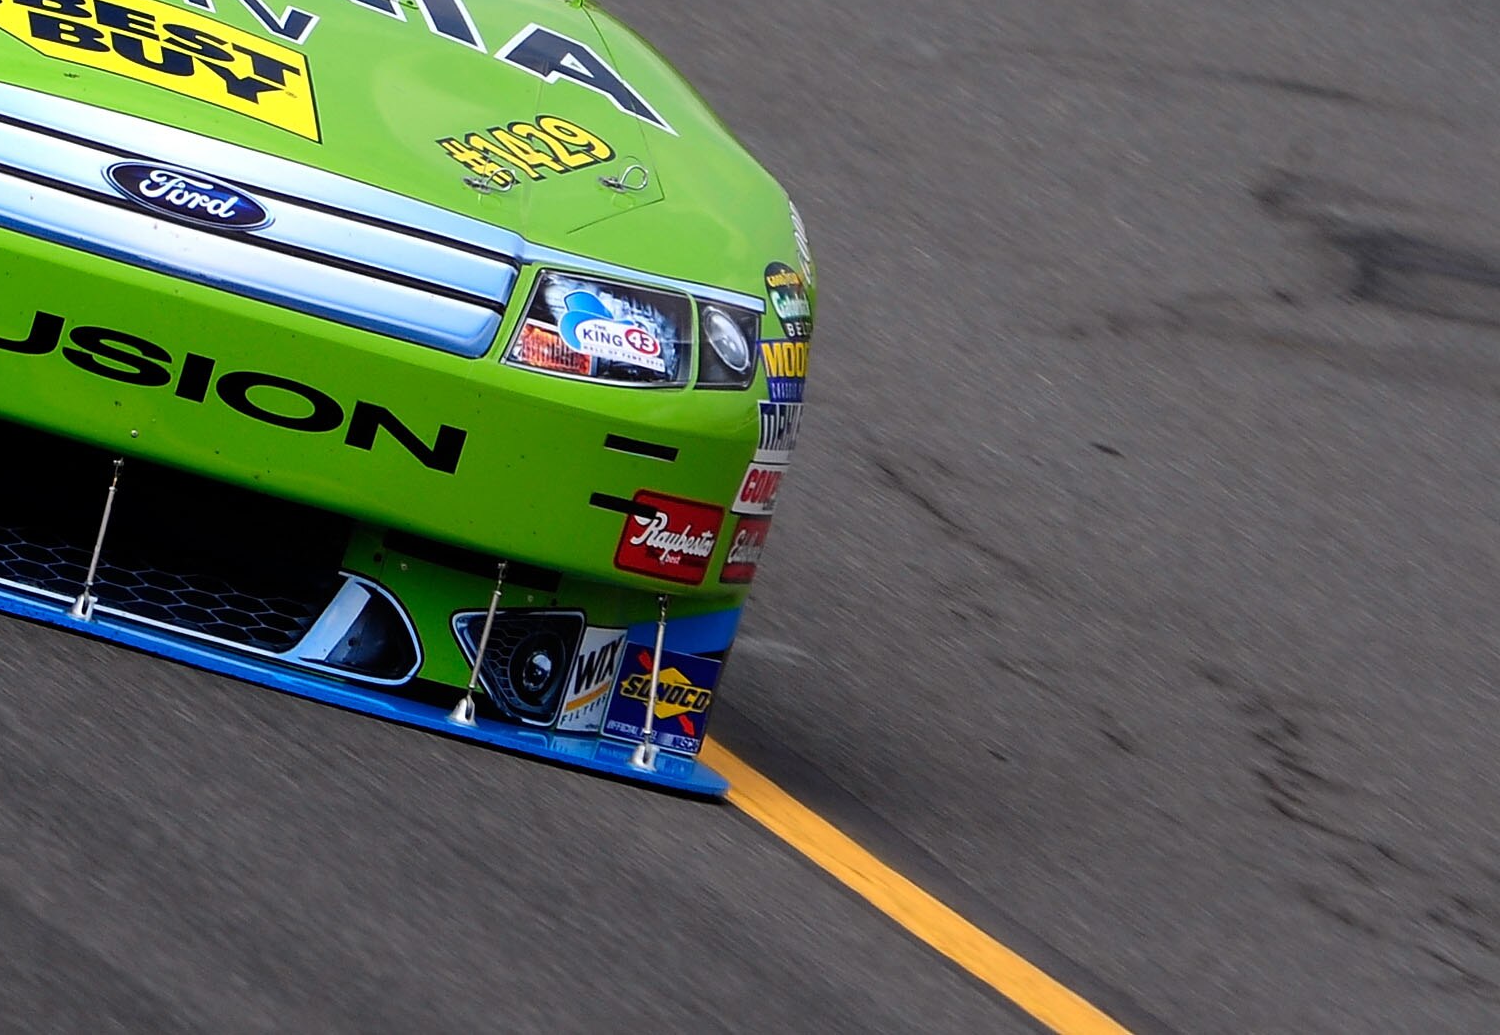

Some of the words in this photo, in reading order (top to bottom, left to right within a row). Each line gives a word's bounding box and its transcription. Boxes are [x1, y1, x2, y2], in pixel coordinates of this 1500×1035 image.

[29, 8, 284, 106] BUY
[436, 115, 616, 189] #1429
[137, 168, 239, 221] Ford
[583, 328, 623, 347] KING
[628, 329, 653, 353] 43
[762, 341, 809, 378] MOO
[630, 511, 715, 561] Raybestos
[574, 635, 624, 695] WIX
